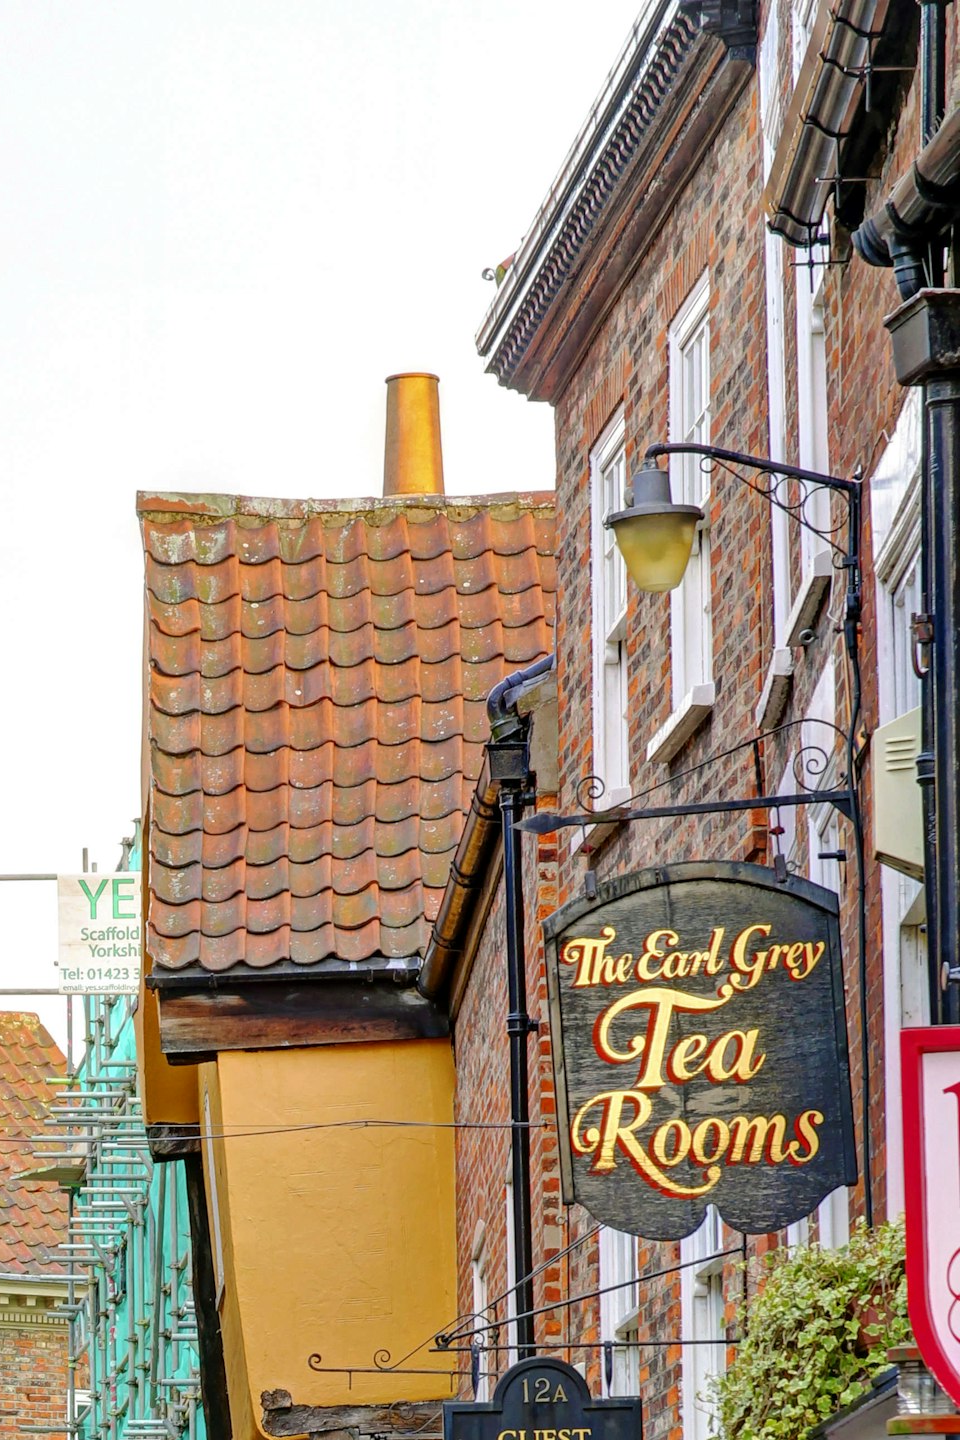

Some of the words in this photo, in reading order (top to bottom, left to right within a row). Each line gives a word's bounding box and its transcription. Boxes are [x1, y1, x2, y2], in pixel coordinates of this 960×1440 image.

[78, 878, 142, 920] YE
[60, 968, 84, 980] Tel:
[87, 968, 130, 980] 01423
[560, 926, 633, 988] The
[634, 928, 726, 981] Earl
[727, 925, 826, 990] Grey
[63, 984, 84, 992] email:
[592, 987, 767, 1092] Tea
[571, 1090, 825, 1199] Rooms
[522, 1378, 568, 1403] 12A
